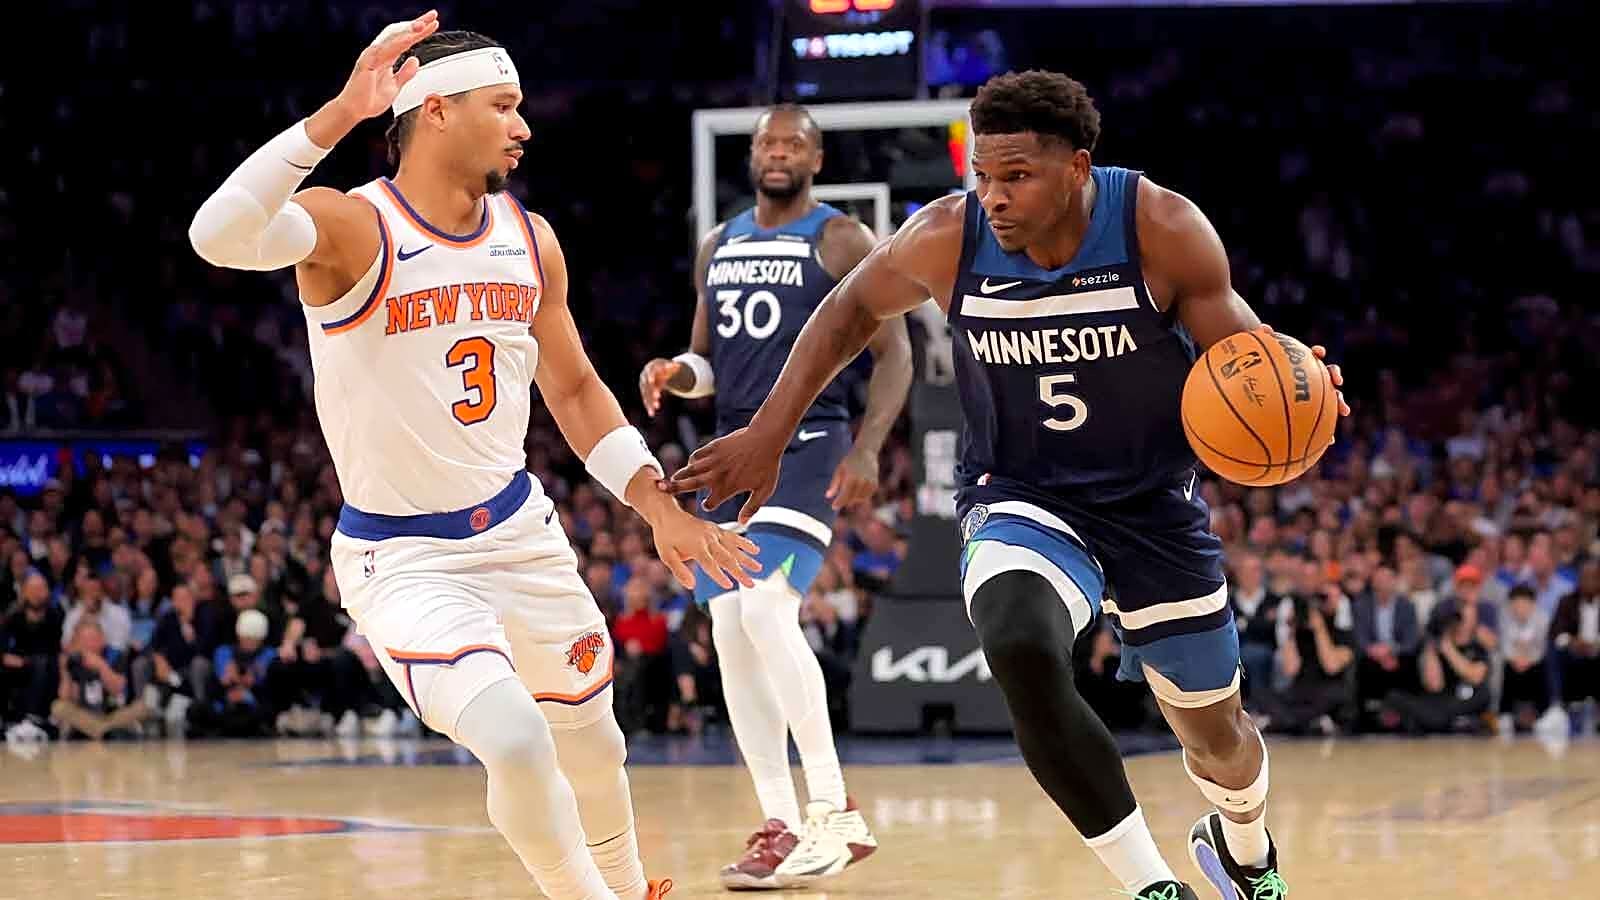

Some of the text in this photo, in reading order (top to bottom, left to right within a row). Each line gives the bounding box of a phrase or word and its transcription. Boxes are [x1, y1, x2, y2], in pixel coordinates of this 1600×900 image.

[706, 259, 803, 287] MINNESOTA
[1080, 272, 1120, 286] sezzle
[385, 282, 537, 336] NEW YORK
[716, 290, 781, 339] 30
[967, 325, 1138, 365] MINNESOTA
[446, 336, 497, 426] 3
[1039, 374, 1088, 431] 5
